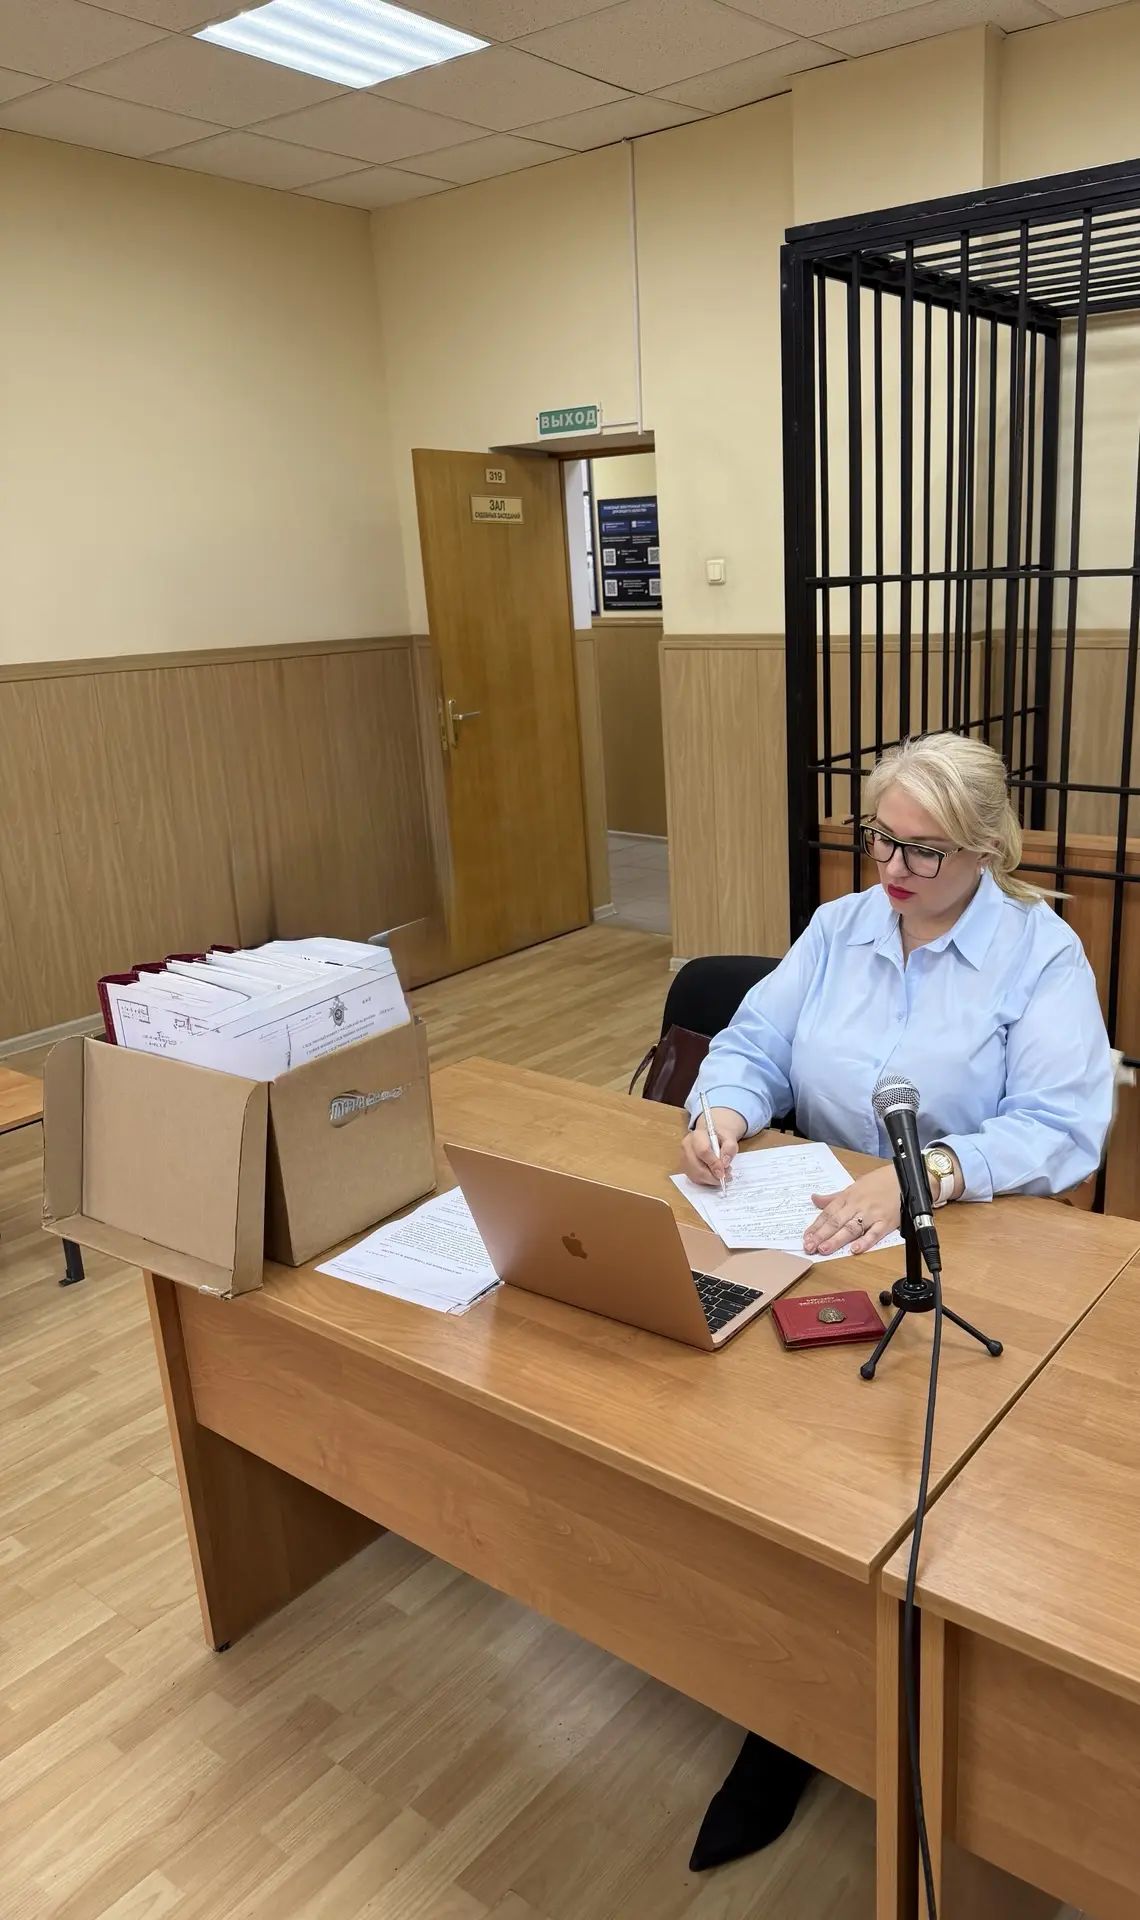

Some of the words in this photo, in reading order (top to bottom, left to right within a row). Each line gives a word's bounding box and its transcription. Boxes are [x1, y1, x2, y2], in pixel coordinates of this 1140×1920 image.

[541, 409, 597, 429] ВЫХОД
[489, 471, 503, 481] 319
[489, 499, 506, 511] ЗАЛ
